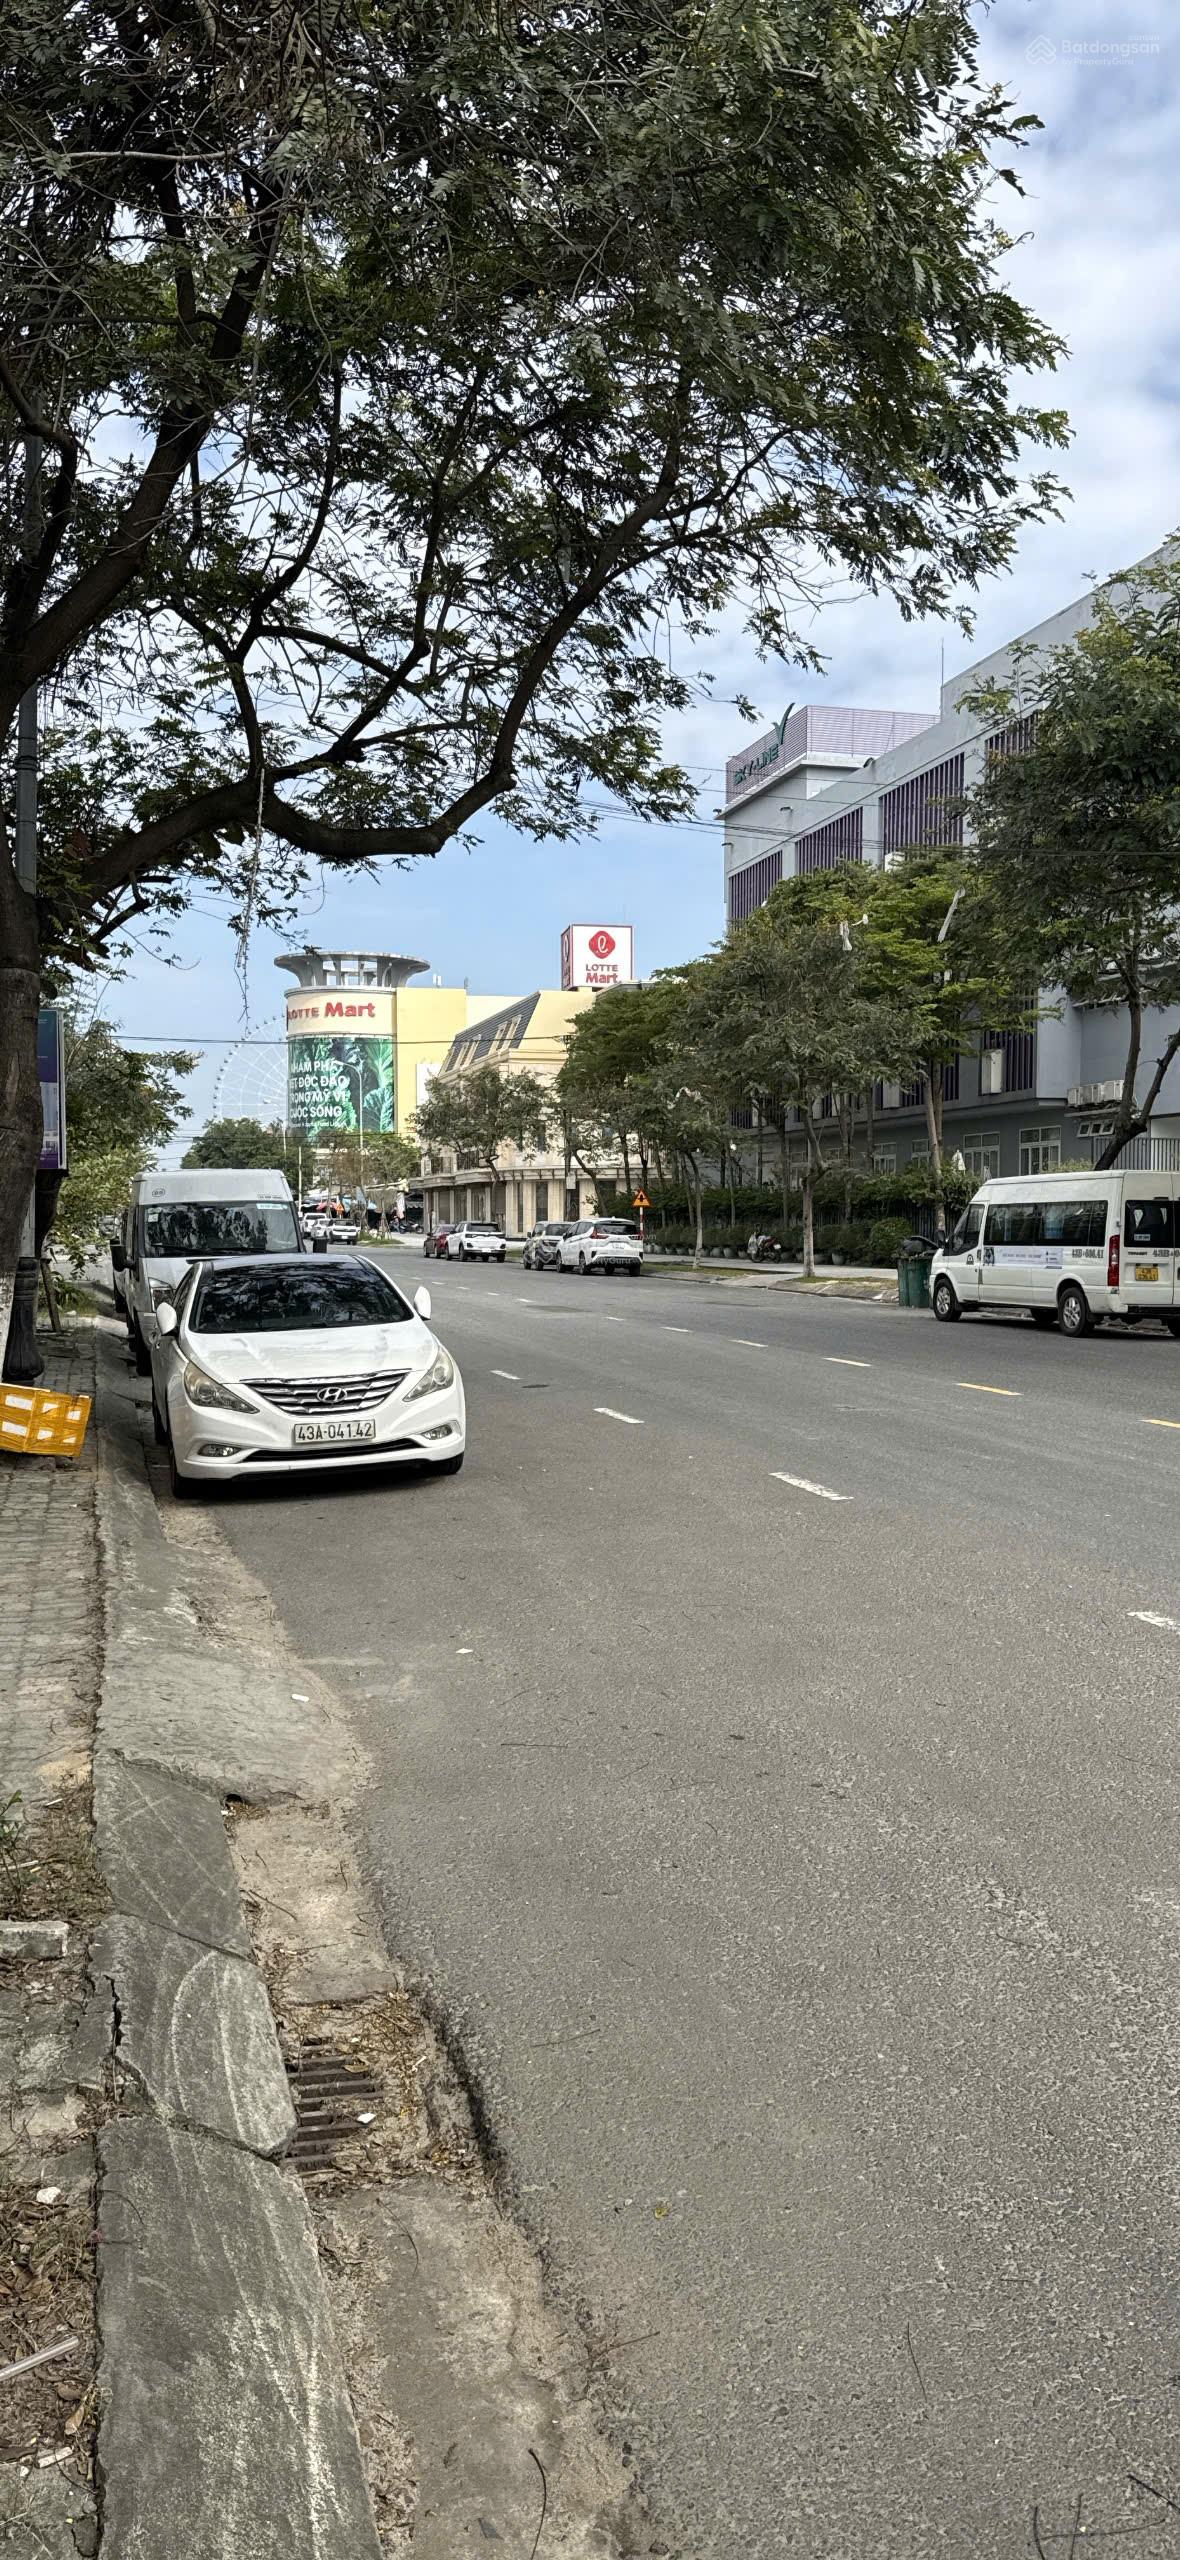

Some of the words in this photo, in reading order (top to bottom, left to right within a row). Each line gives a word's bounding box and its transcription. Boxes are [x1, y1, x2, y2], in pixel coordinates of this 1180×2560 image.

[585, 963, 619, 972] LOTTE
[585, 972, 619, 984] Mart
[324, 1002, 376, 1018] Mart
[298, 1422, 372, 1441] 43A-041.42
